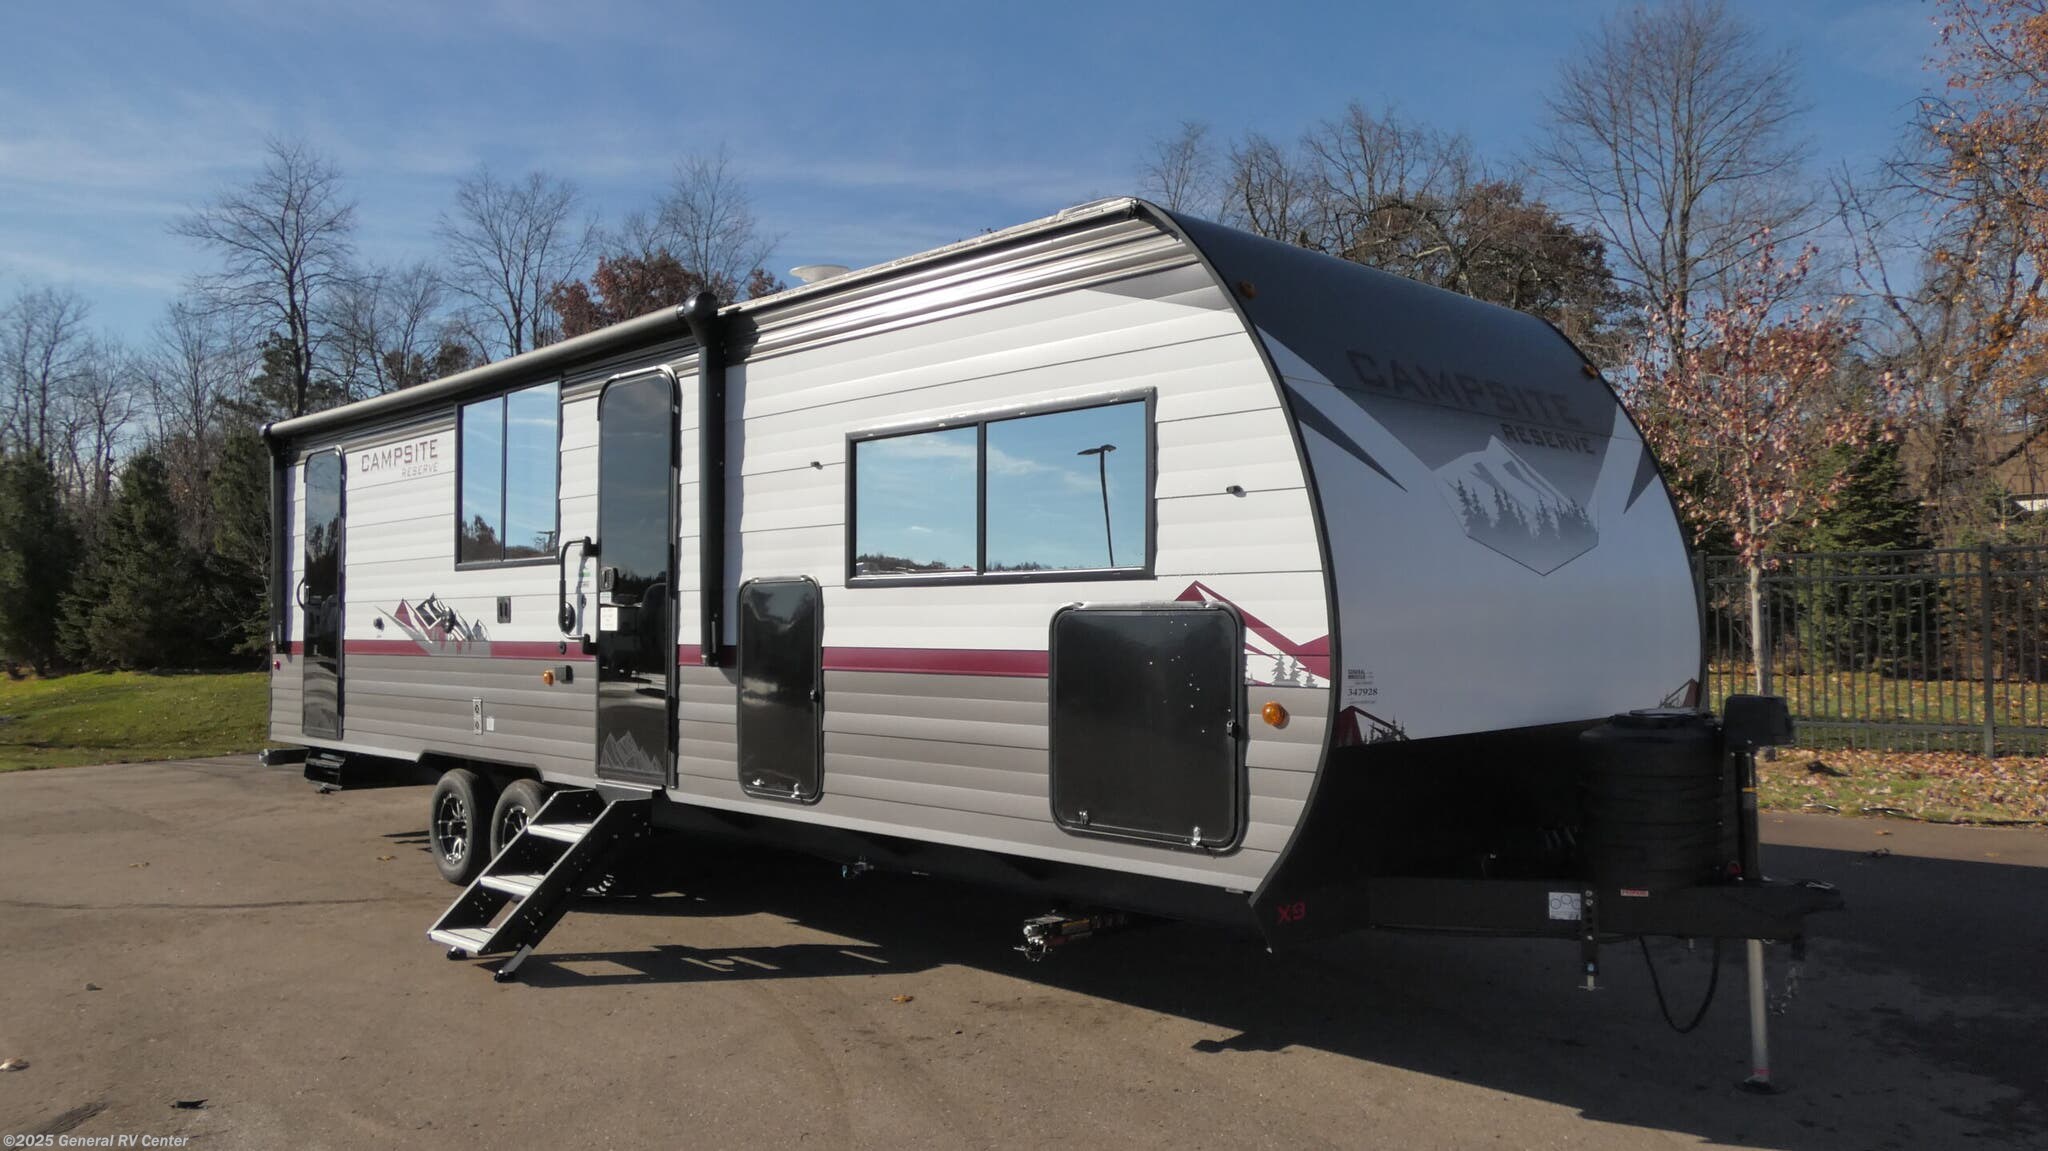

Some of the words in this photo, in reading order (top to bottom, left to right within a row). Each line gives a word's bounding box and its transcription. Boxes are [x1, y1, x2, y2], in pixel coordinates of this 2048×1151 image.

[1345, 348, 1584, 426] CAMPSITE
[361, 438, 439, 473] CAMPSITE
[1499, 422, 1597, 456] RESERVE
[401, 462, 439, 478] RESERVE
[1347, 687, 1378, 697] 347928
